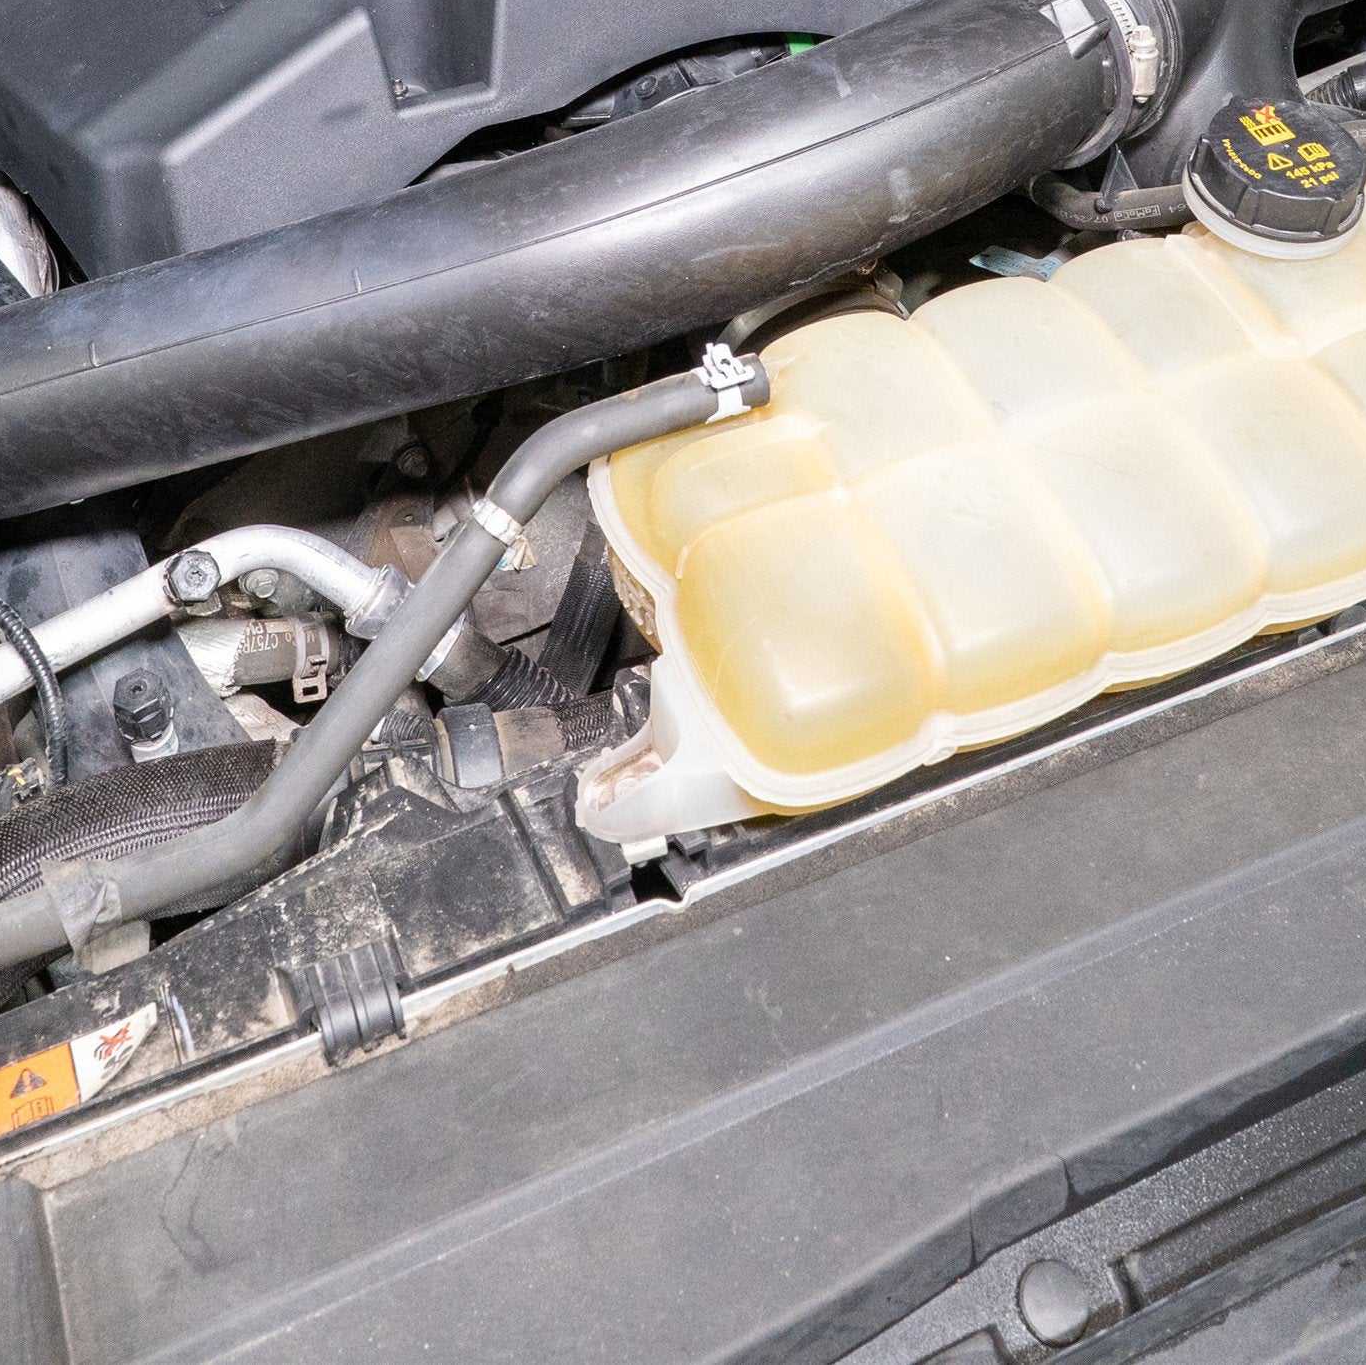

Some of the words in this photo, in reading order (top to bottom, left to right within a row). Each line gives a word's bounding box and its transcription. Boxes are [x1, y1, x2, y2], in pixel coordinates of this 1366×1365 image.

[1286, 167, 1310, 179] 145
[1309, 161, 1335, 174] kPa
[1300, 177, 1318, 189] 21
[1319, 171, 1340, 185] psi
[1115, 206, 1159, 220] FoMoCo
